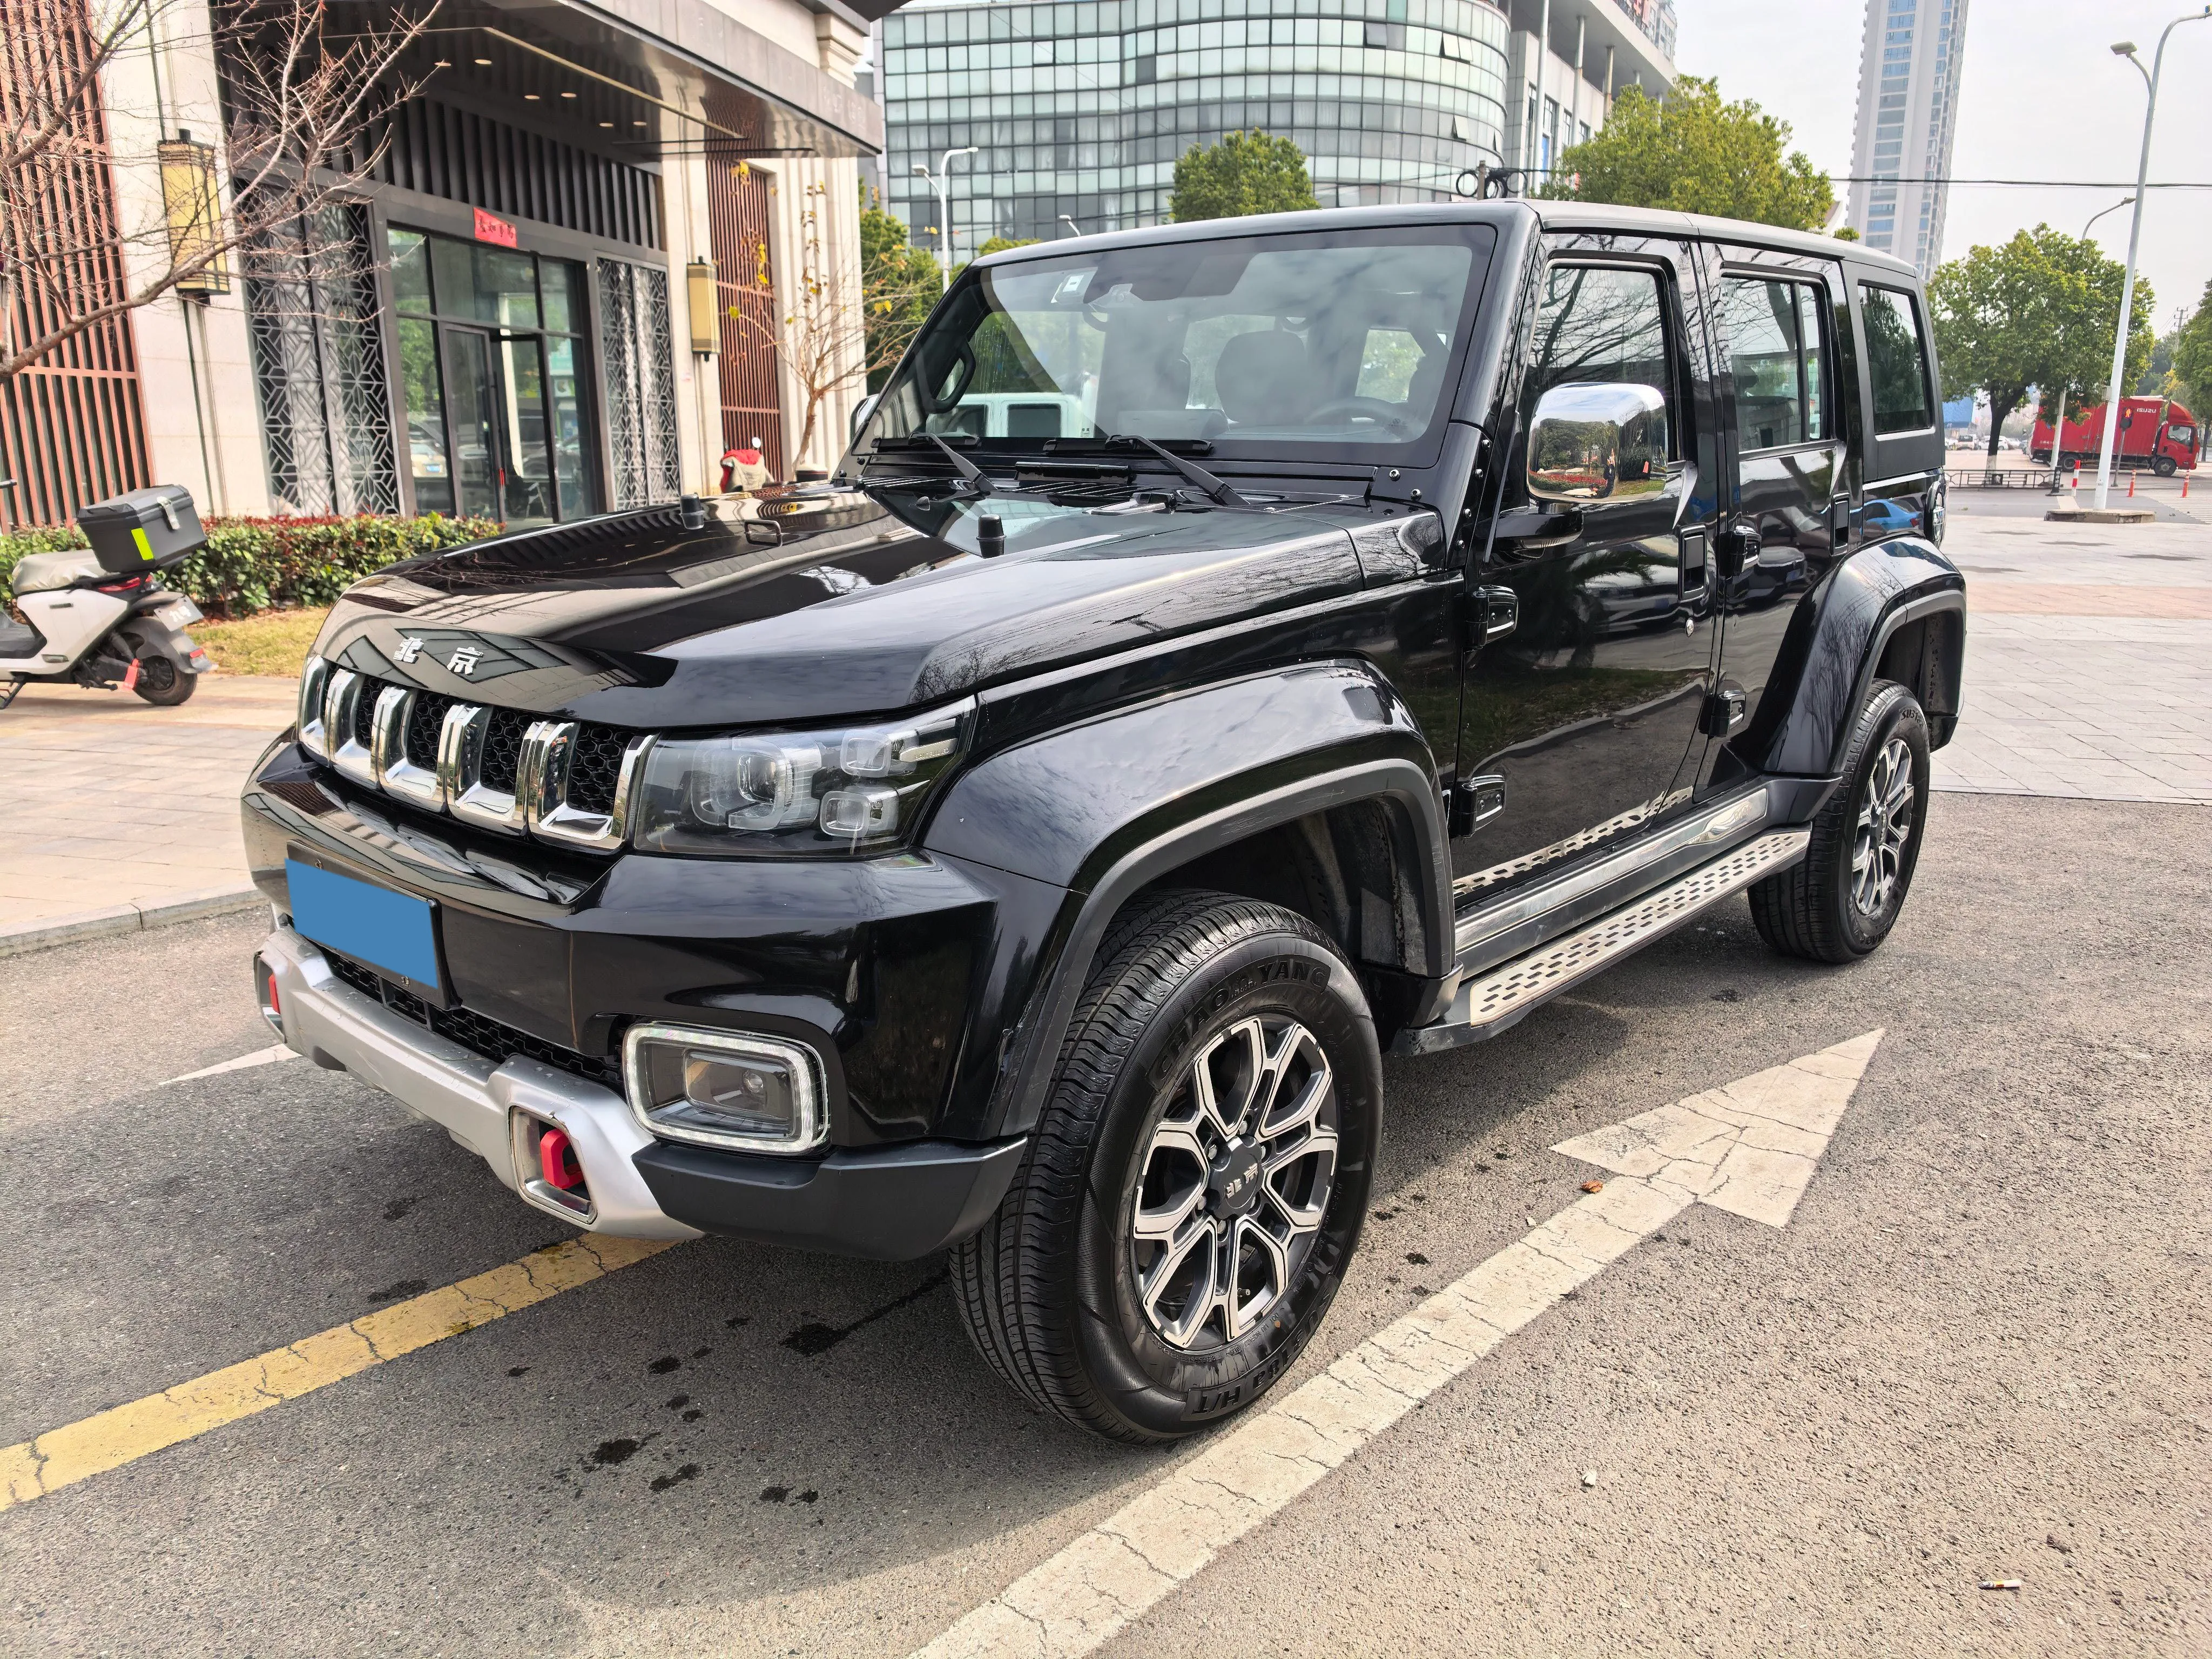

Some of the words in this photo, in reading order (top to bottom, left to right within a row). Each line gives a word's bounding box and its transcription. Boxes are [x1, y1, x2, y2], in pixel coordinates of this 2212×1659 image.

[393, 636, 484, 676] 北京
[1155, 988, 1230, 1081] CHAO
[1257, 959, 1332, 993] YANG
